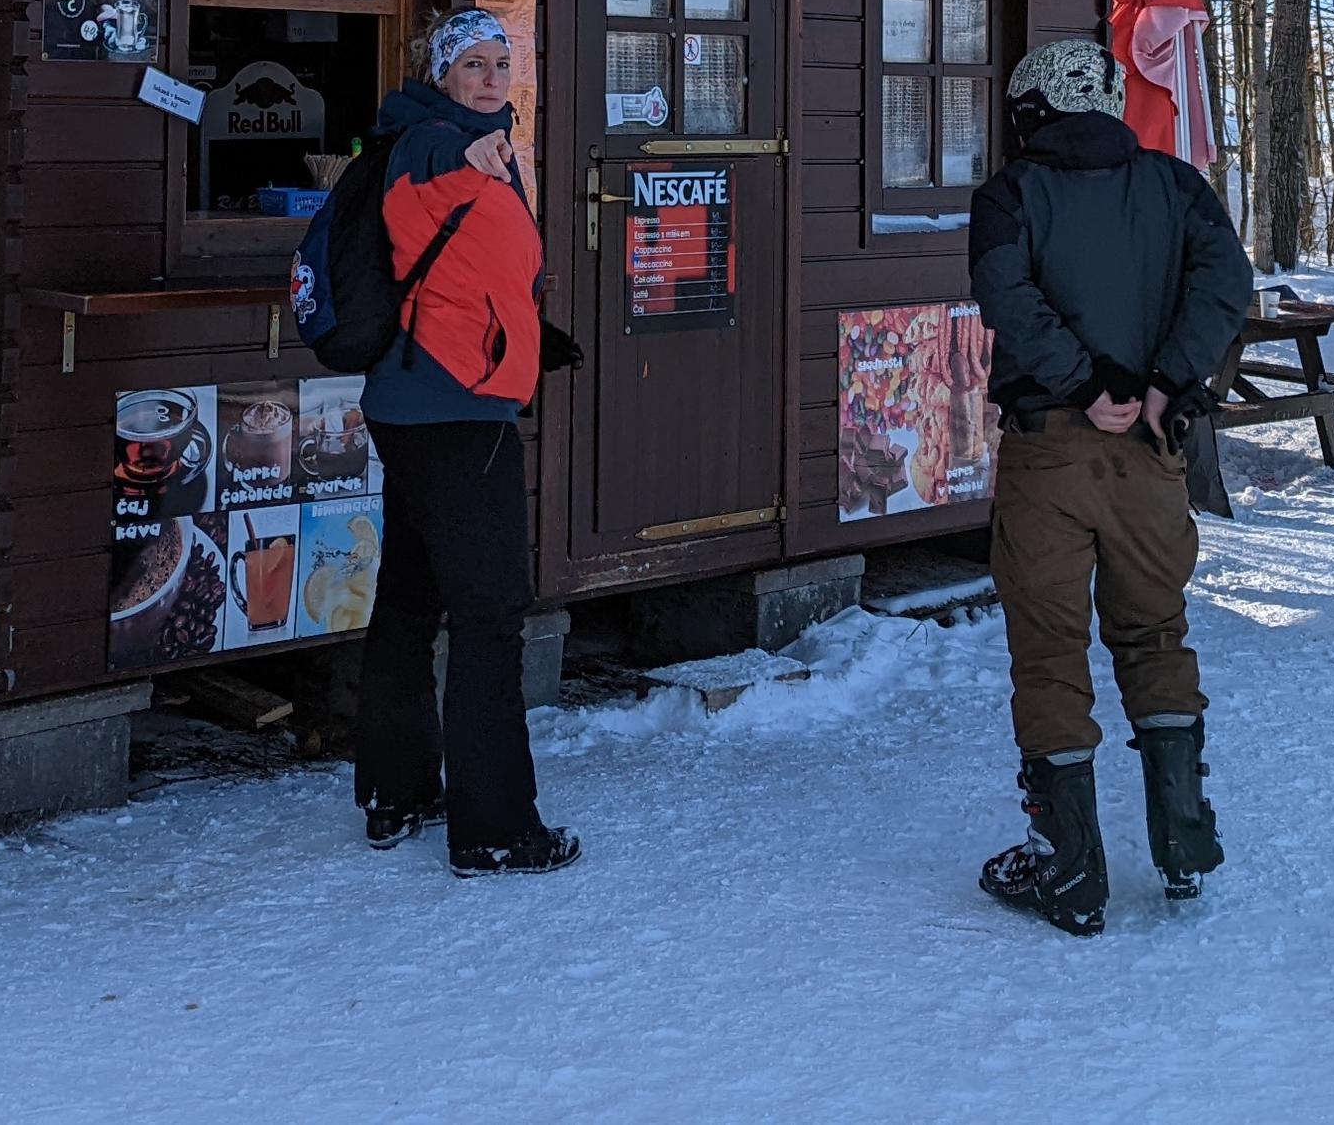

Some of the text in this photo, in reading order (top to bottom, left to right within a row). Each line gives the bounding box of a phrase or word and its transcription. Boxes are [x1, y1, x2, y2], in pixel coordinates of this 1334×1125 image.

[67, 0, 77, 12] C
[228, 110, 302, 134] Red Bull
[633, 170, 728, 207] NESCAFÉ
[634, 216, 661, 228] Espresso
[634, 231, 660, 244] Espresso
[634, 244, 673, 256] Cappuccino
[633, 304, 645, 315] Čaj
[949, 305, 981, 318] klobás
[232, 463, 281, 483] horká
[220, 483, 294, 506] čokoláda
[306, 476, 363, 496] svařák
[938, 486, 946, 497] v
[116, 498, 149, 516] čaj
[115, 522, 162, 541] káva
[1054, 871, 1087, 896] SALOMON
